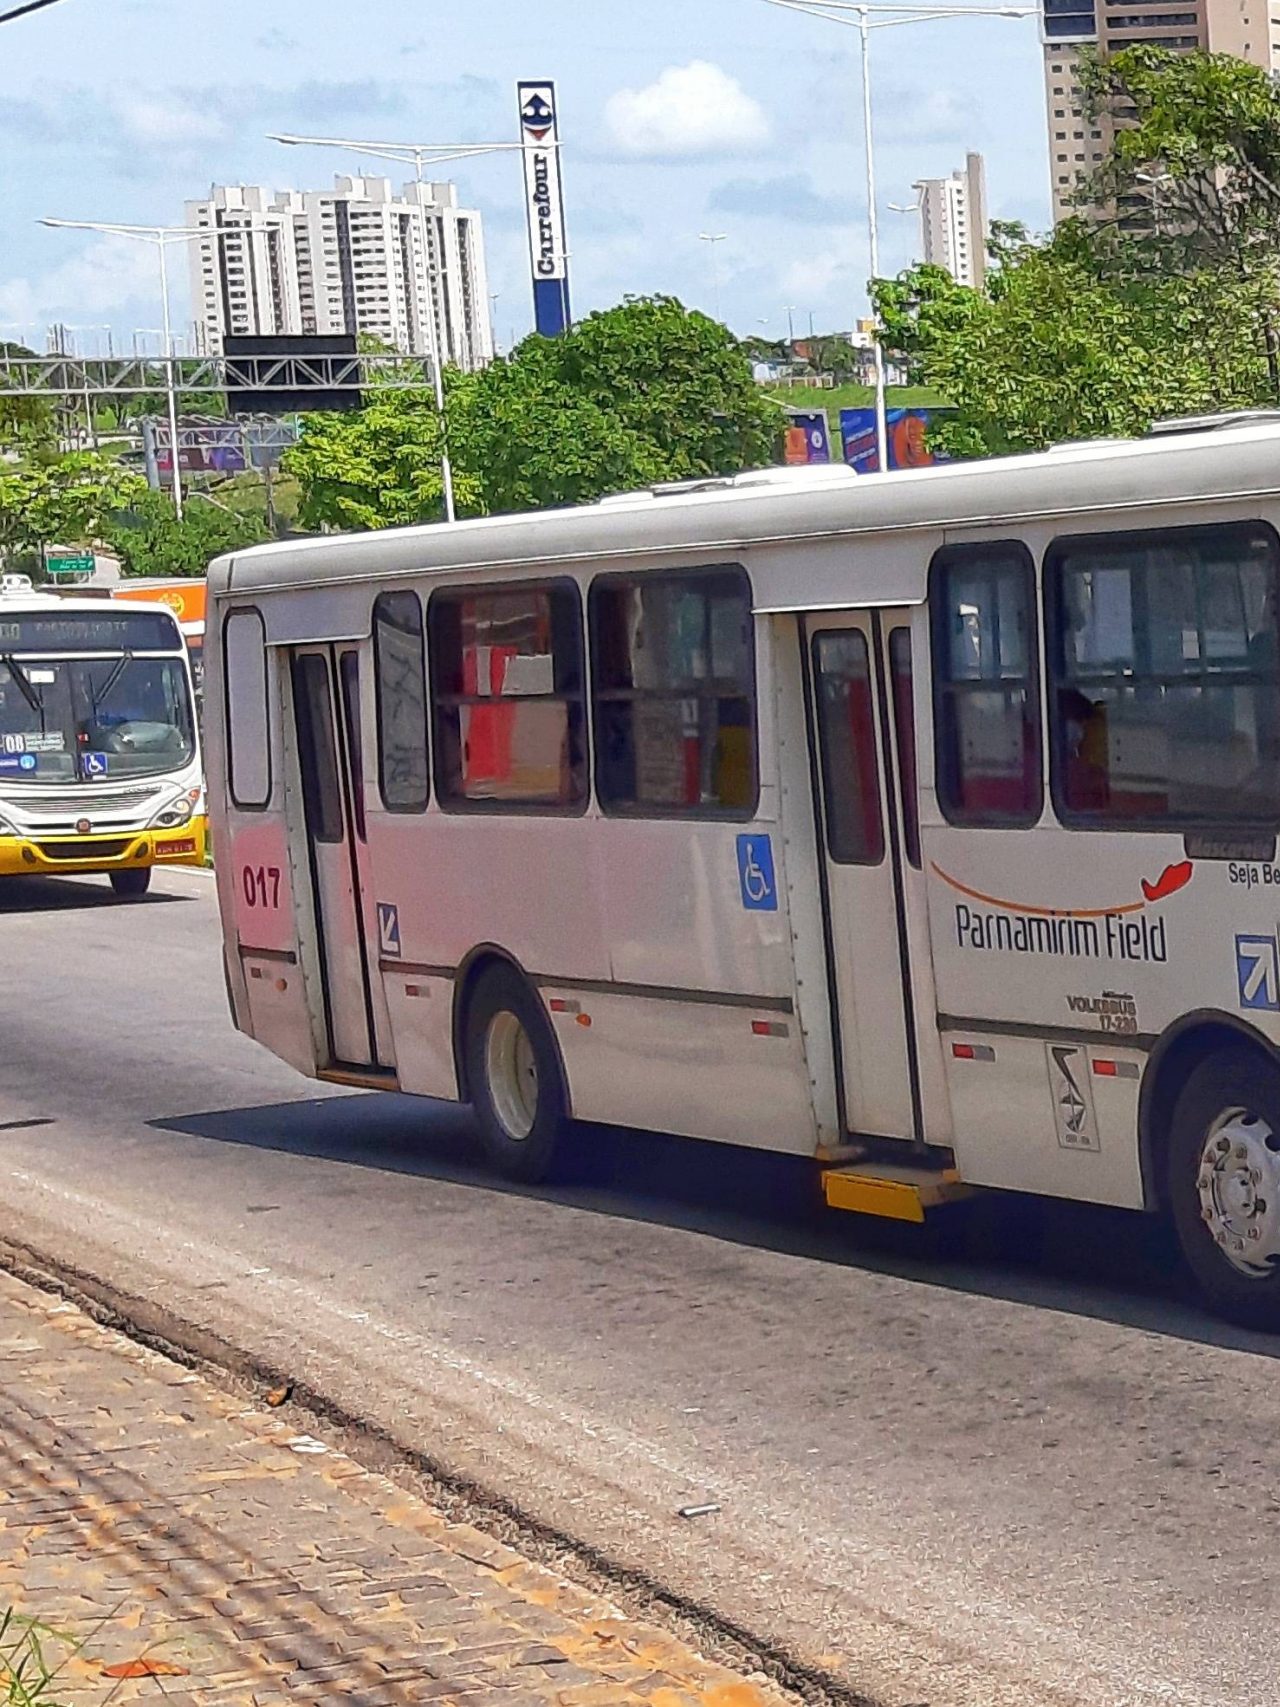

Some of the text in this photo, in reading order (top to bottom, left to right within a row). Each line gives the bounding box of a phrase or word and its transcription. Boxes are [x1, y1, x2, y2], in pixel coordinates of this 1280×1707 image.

[534, 153, 555, 275] Carrefour
[243, 865, 280, 909] 017
[1229, 862, 1259, 889] Seja
[956, 904, 1167, 963] Parnamirim Field
